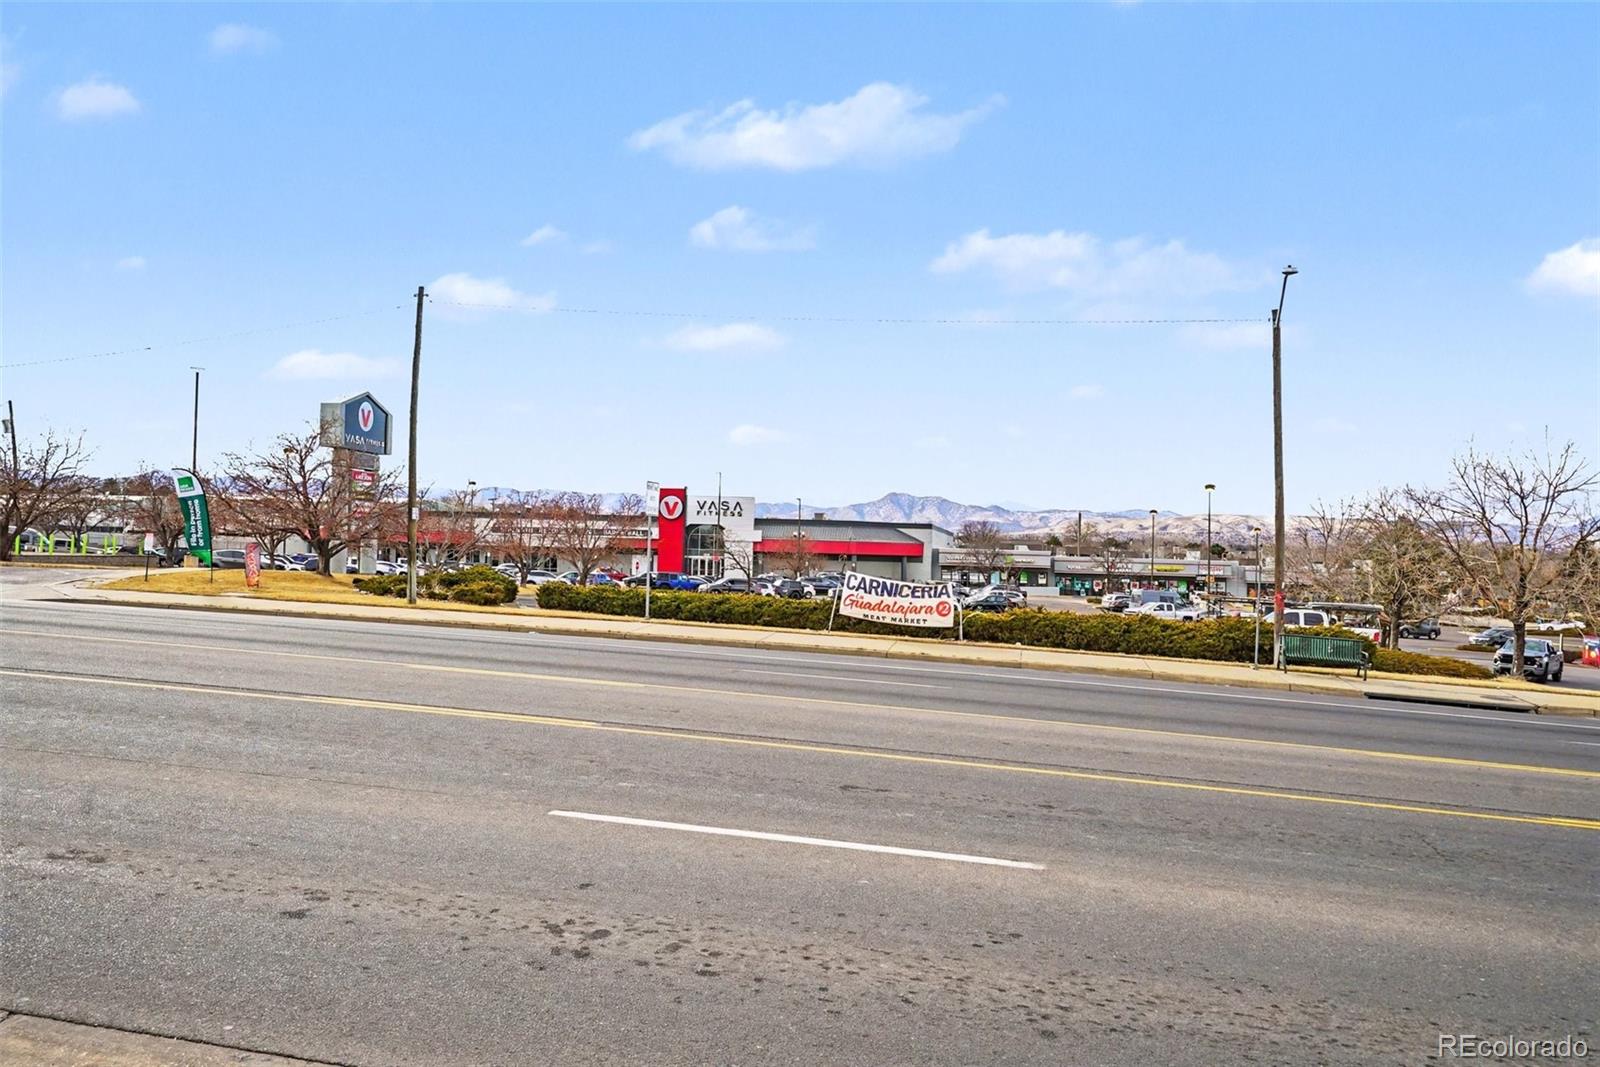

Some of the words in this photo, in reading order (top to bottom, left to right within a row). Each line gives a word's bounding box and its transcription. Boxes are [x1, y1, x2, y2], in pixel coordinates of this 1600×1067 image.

[663, 501, 679, 516] V
[696, 500, 743, 512] VASA
[846, 574, 951, 598] CARNICERIA
[843, 593, 934, 618] Guadalajara
[863, 613, 887, 622] MEAT
[890, 615, 928, 625] MARKET
